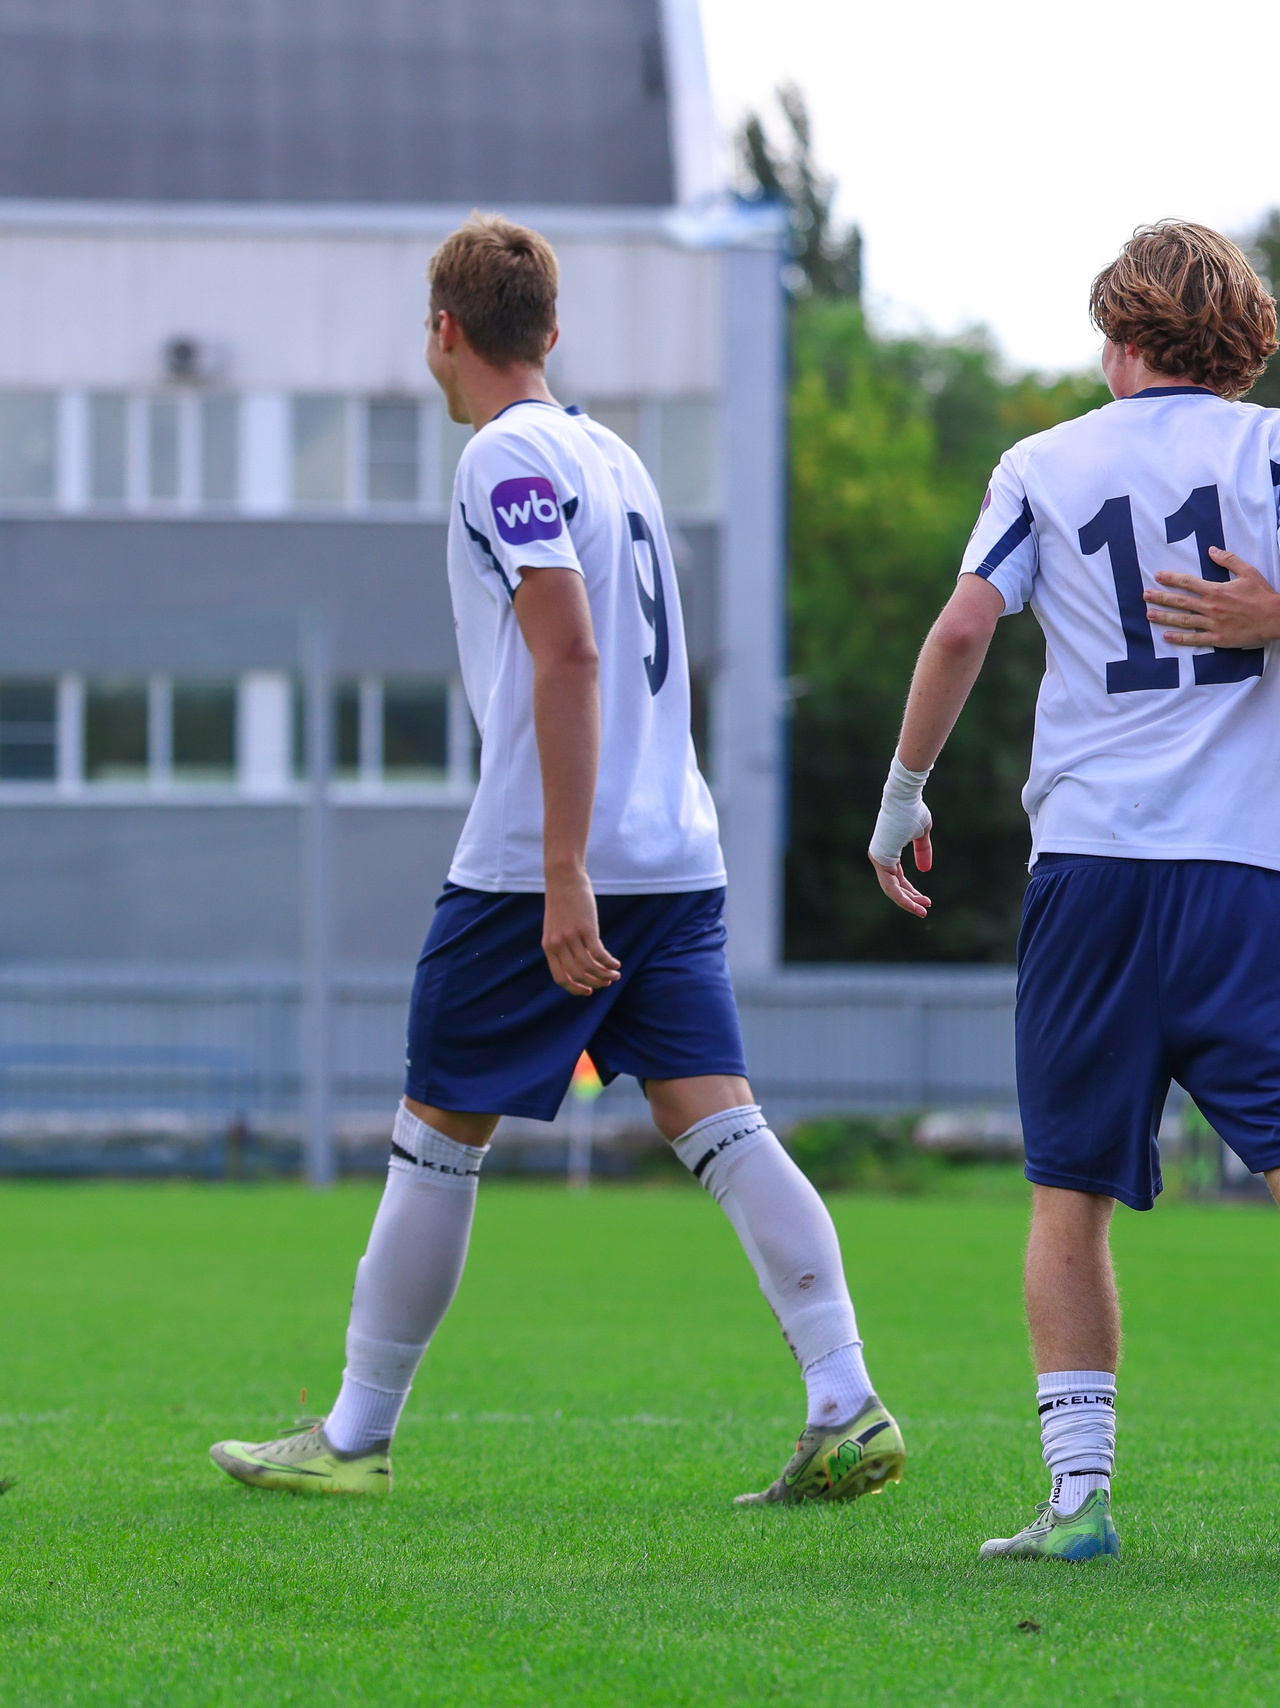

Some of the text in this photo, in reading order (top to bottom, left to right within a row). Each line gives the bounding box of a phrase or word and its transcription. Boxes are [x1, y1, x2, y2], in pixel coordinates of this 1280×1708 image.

[496, 489, 558, 529] wb
[1078, 484, 1265, 694] 11
[627, 512, 670, 697] 9
